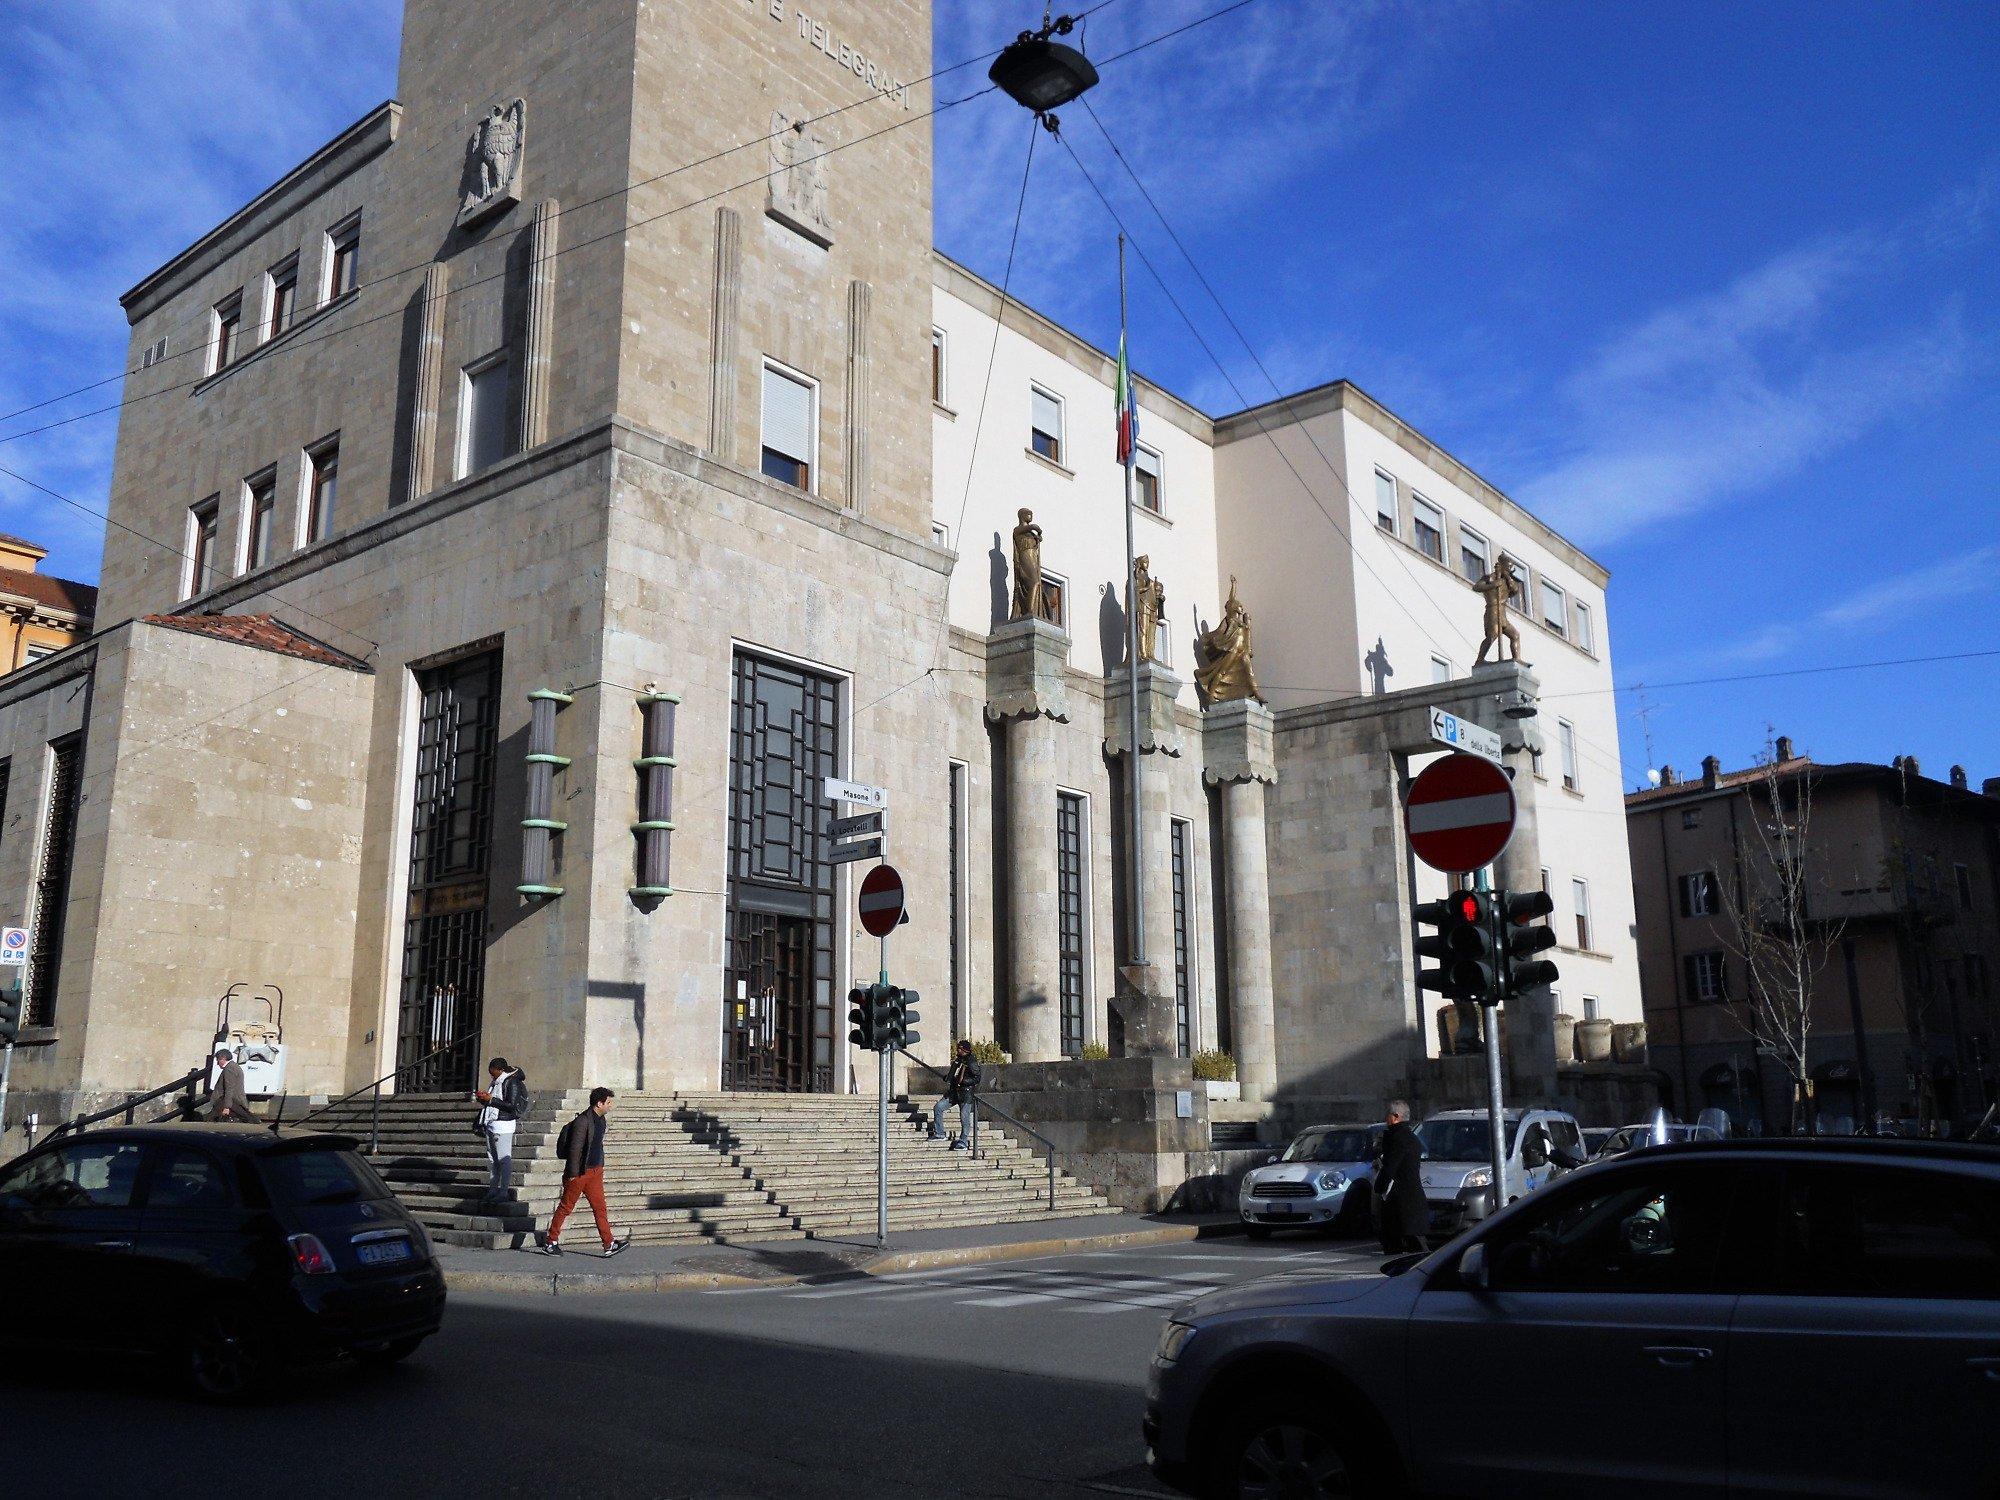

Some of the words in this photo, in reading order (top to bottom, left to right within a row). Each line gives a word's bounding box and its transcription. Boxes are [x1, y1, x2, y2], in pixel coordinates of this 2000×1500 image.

[796, 10, 909, 110] TELEGRAFI
[843, 790, 869, 802] Masone
[839, 822, 868, 834] Locatelli
